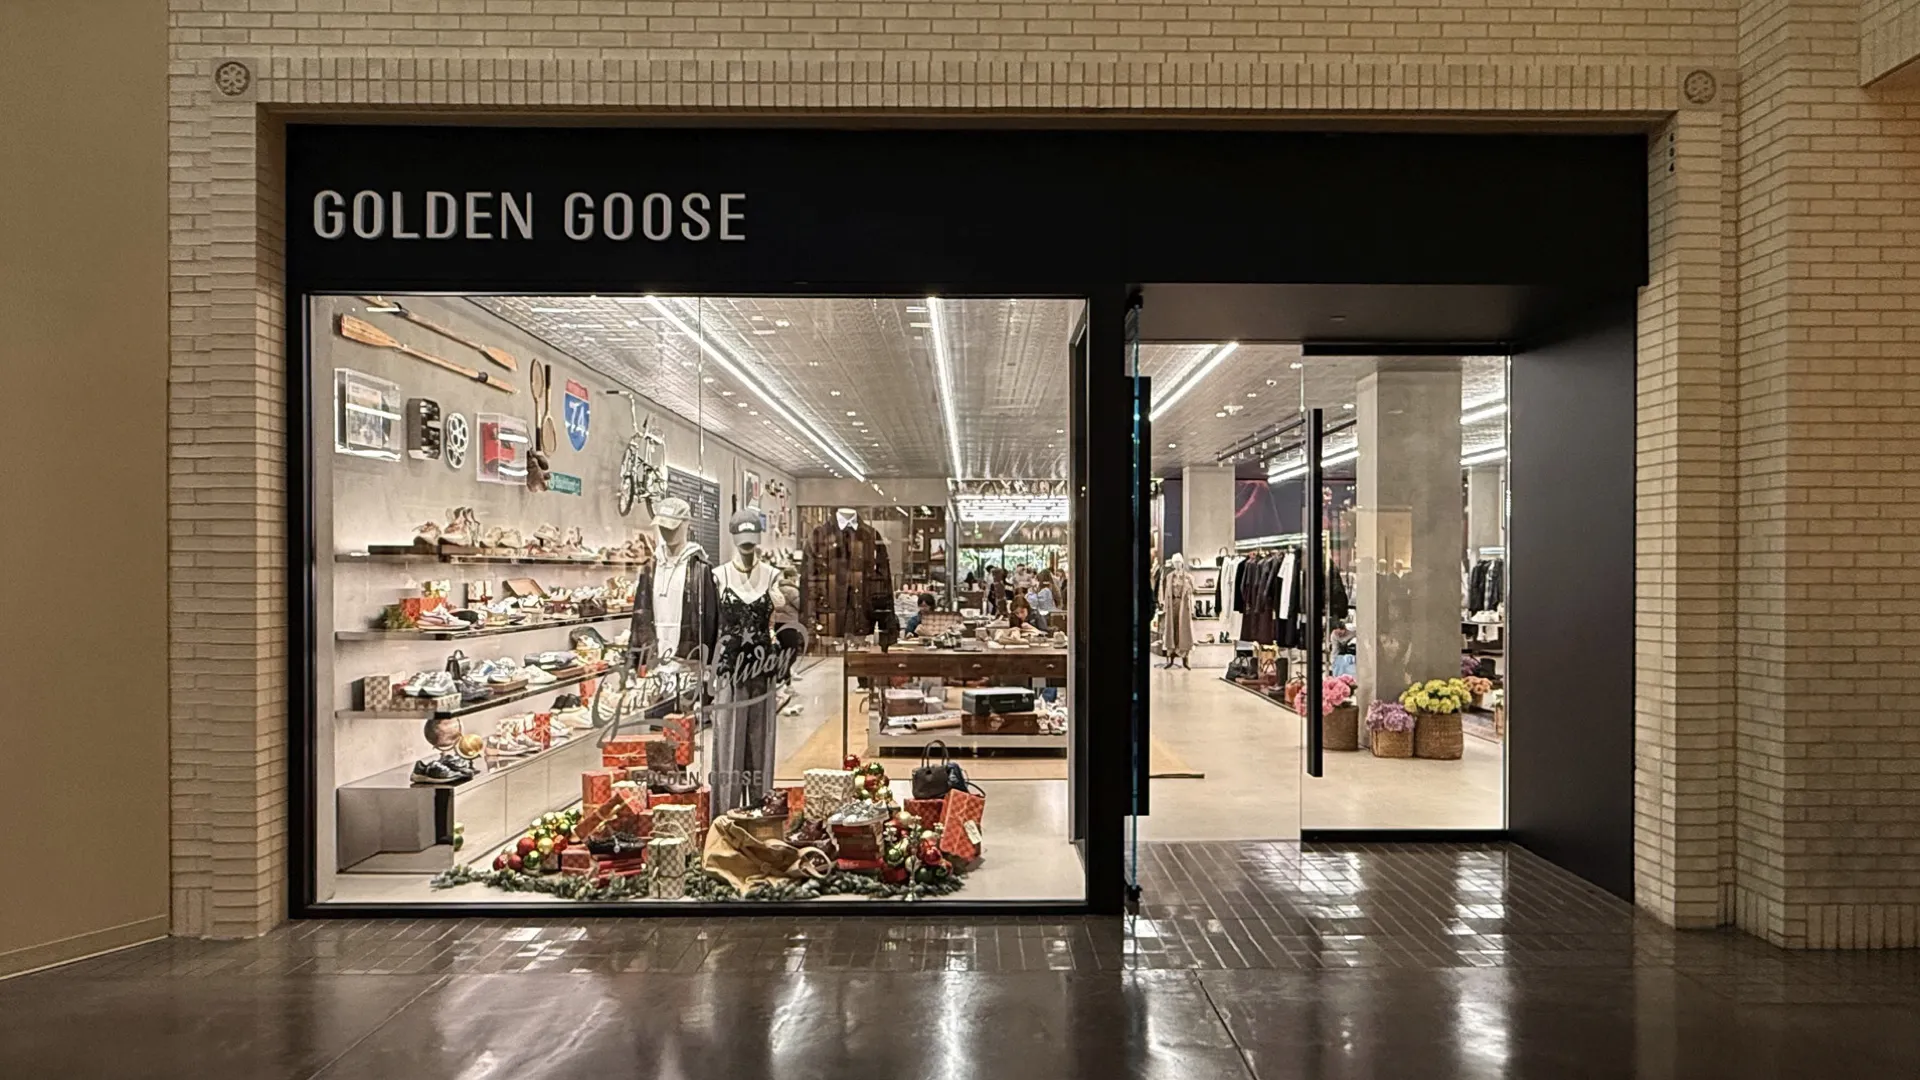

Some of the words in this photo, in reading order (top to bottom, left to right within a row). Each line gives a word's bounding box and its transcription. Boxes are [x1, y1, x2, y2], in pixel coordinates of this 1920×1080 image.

[313, 190, 534, 240] GOLDEN
[564, 191, 747, 241] GOOSE
[684, 624, 806, 708] Holiday
[633, 771, 699, 786] GOLDEN
[708, 770, 762, 786] GOOSE
